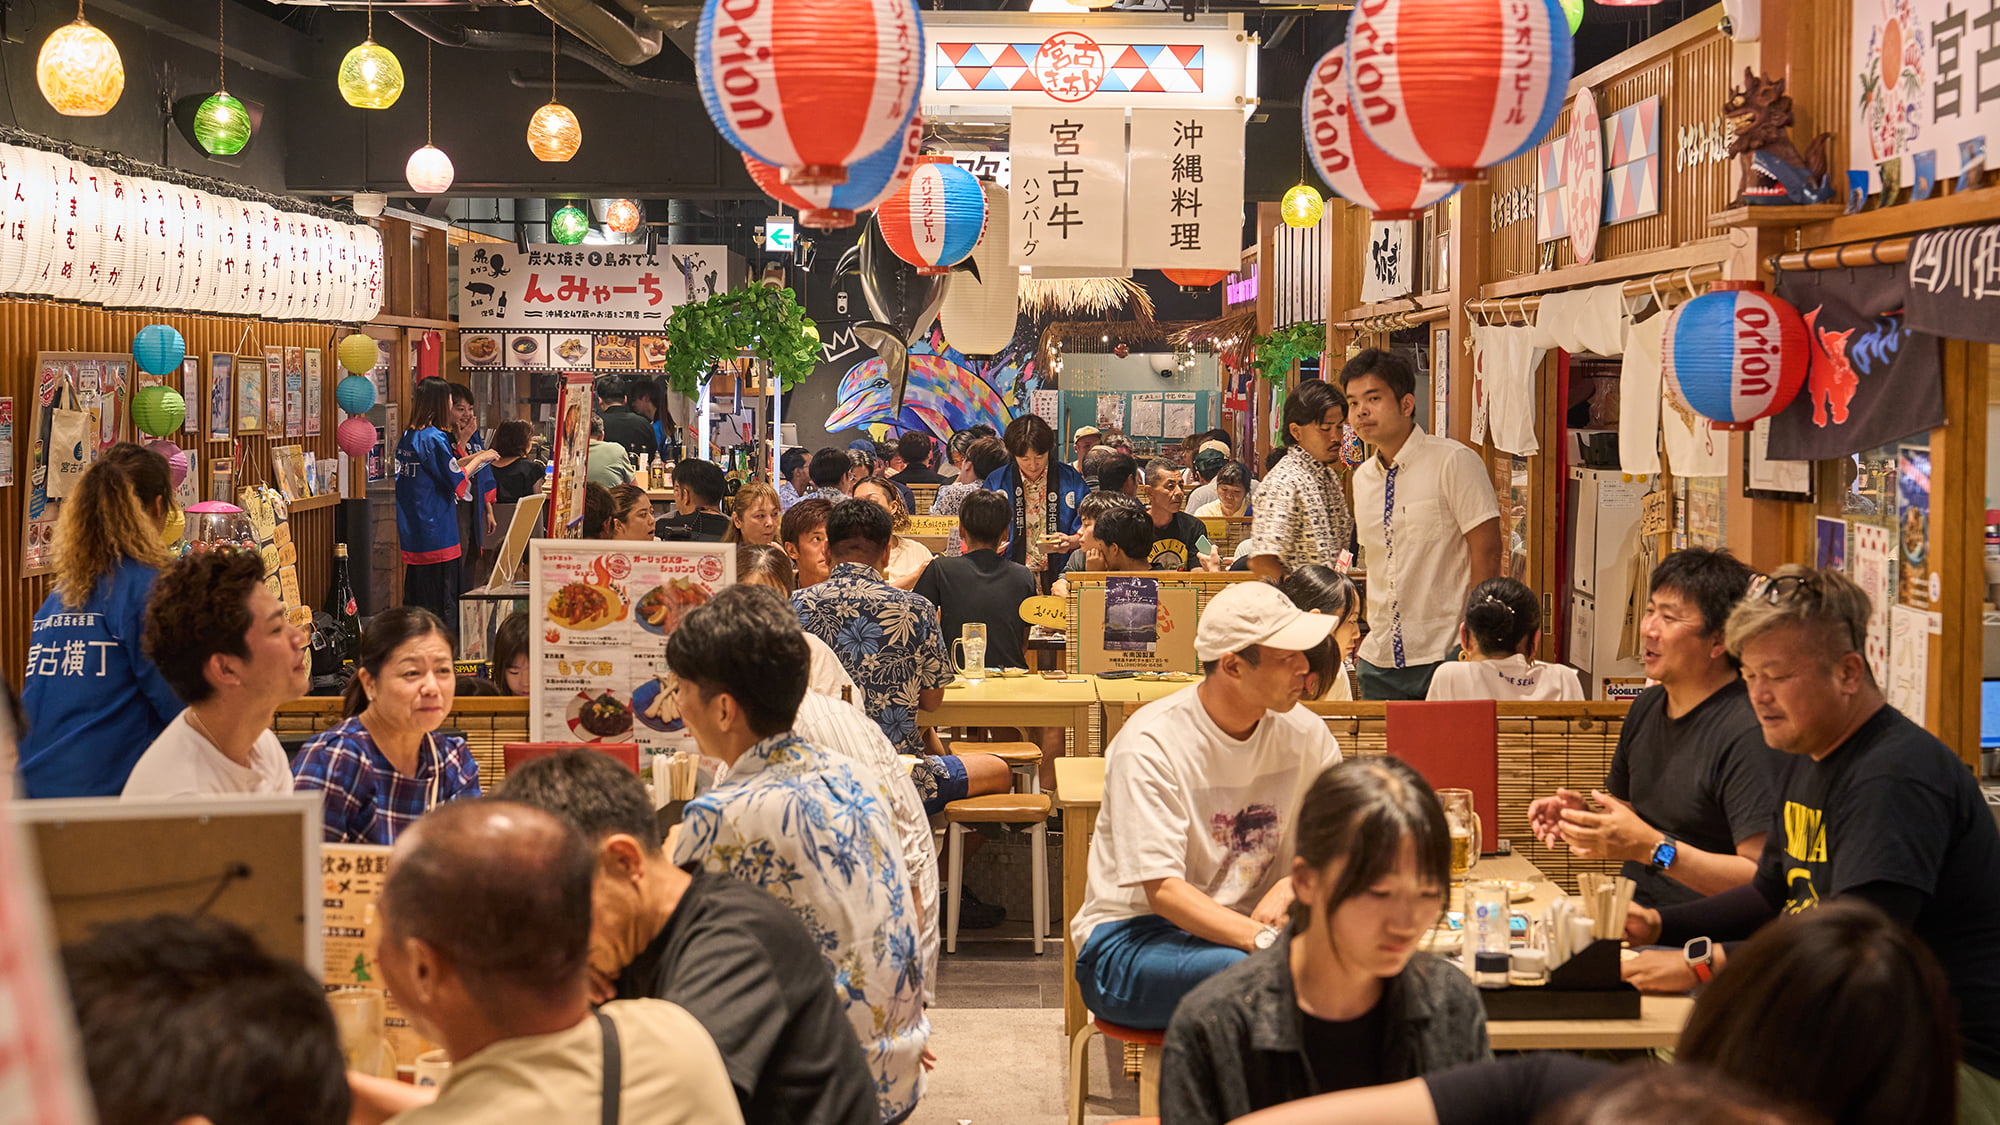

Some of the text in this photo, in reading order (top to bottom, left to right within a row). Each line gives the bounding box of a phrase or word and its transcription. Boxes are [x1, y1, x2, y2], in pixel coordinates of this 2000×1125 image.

[1042, 38, 1100, 72] 宮古
[1312, 56, 1350, 173] Orion
[1047, 119, 1084, 240] 宮古牛
[1169, 119, 1204, 251] 沖縄料理
[921, 176, 936, 243] オリオンビール
[1022, 177, 1040, 257] ハンバーグ
[528, 251, 660, 267] 炭火焼きと島おでん
[524, 272, 664, 307] んみゃーち
[1735, 306, 1780, 396] Orion
[633, 555, 689, 564] ガーリックバター
[660, 565, 696, 573] シュリンプ
[454, 665, 478, 673] SPAM
[558, 660, 613, 676] もずく酢
